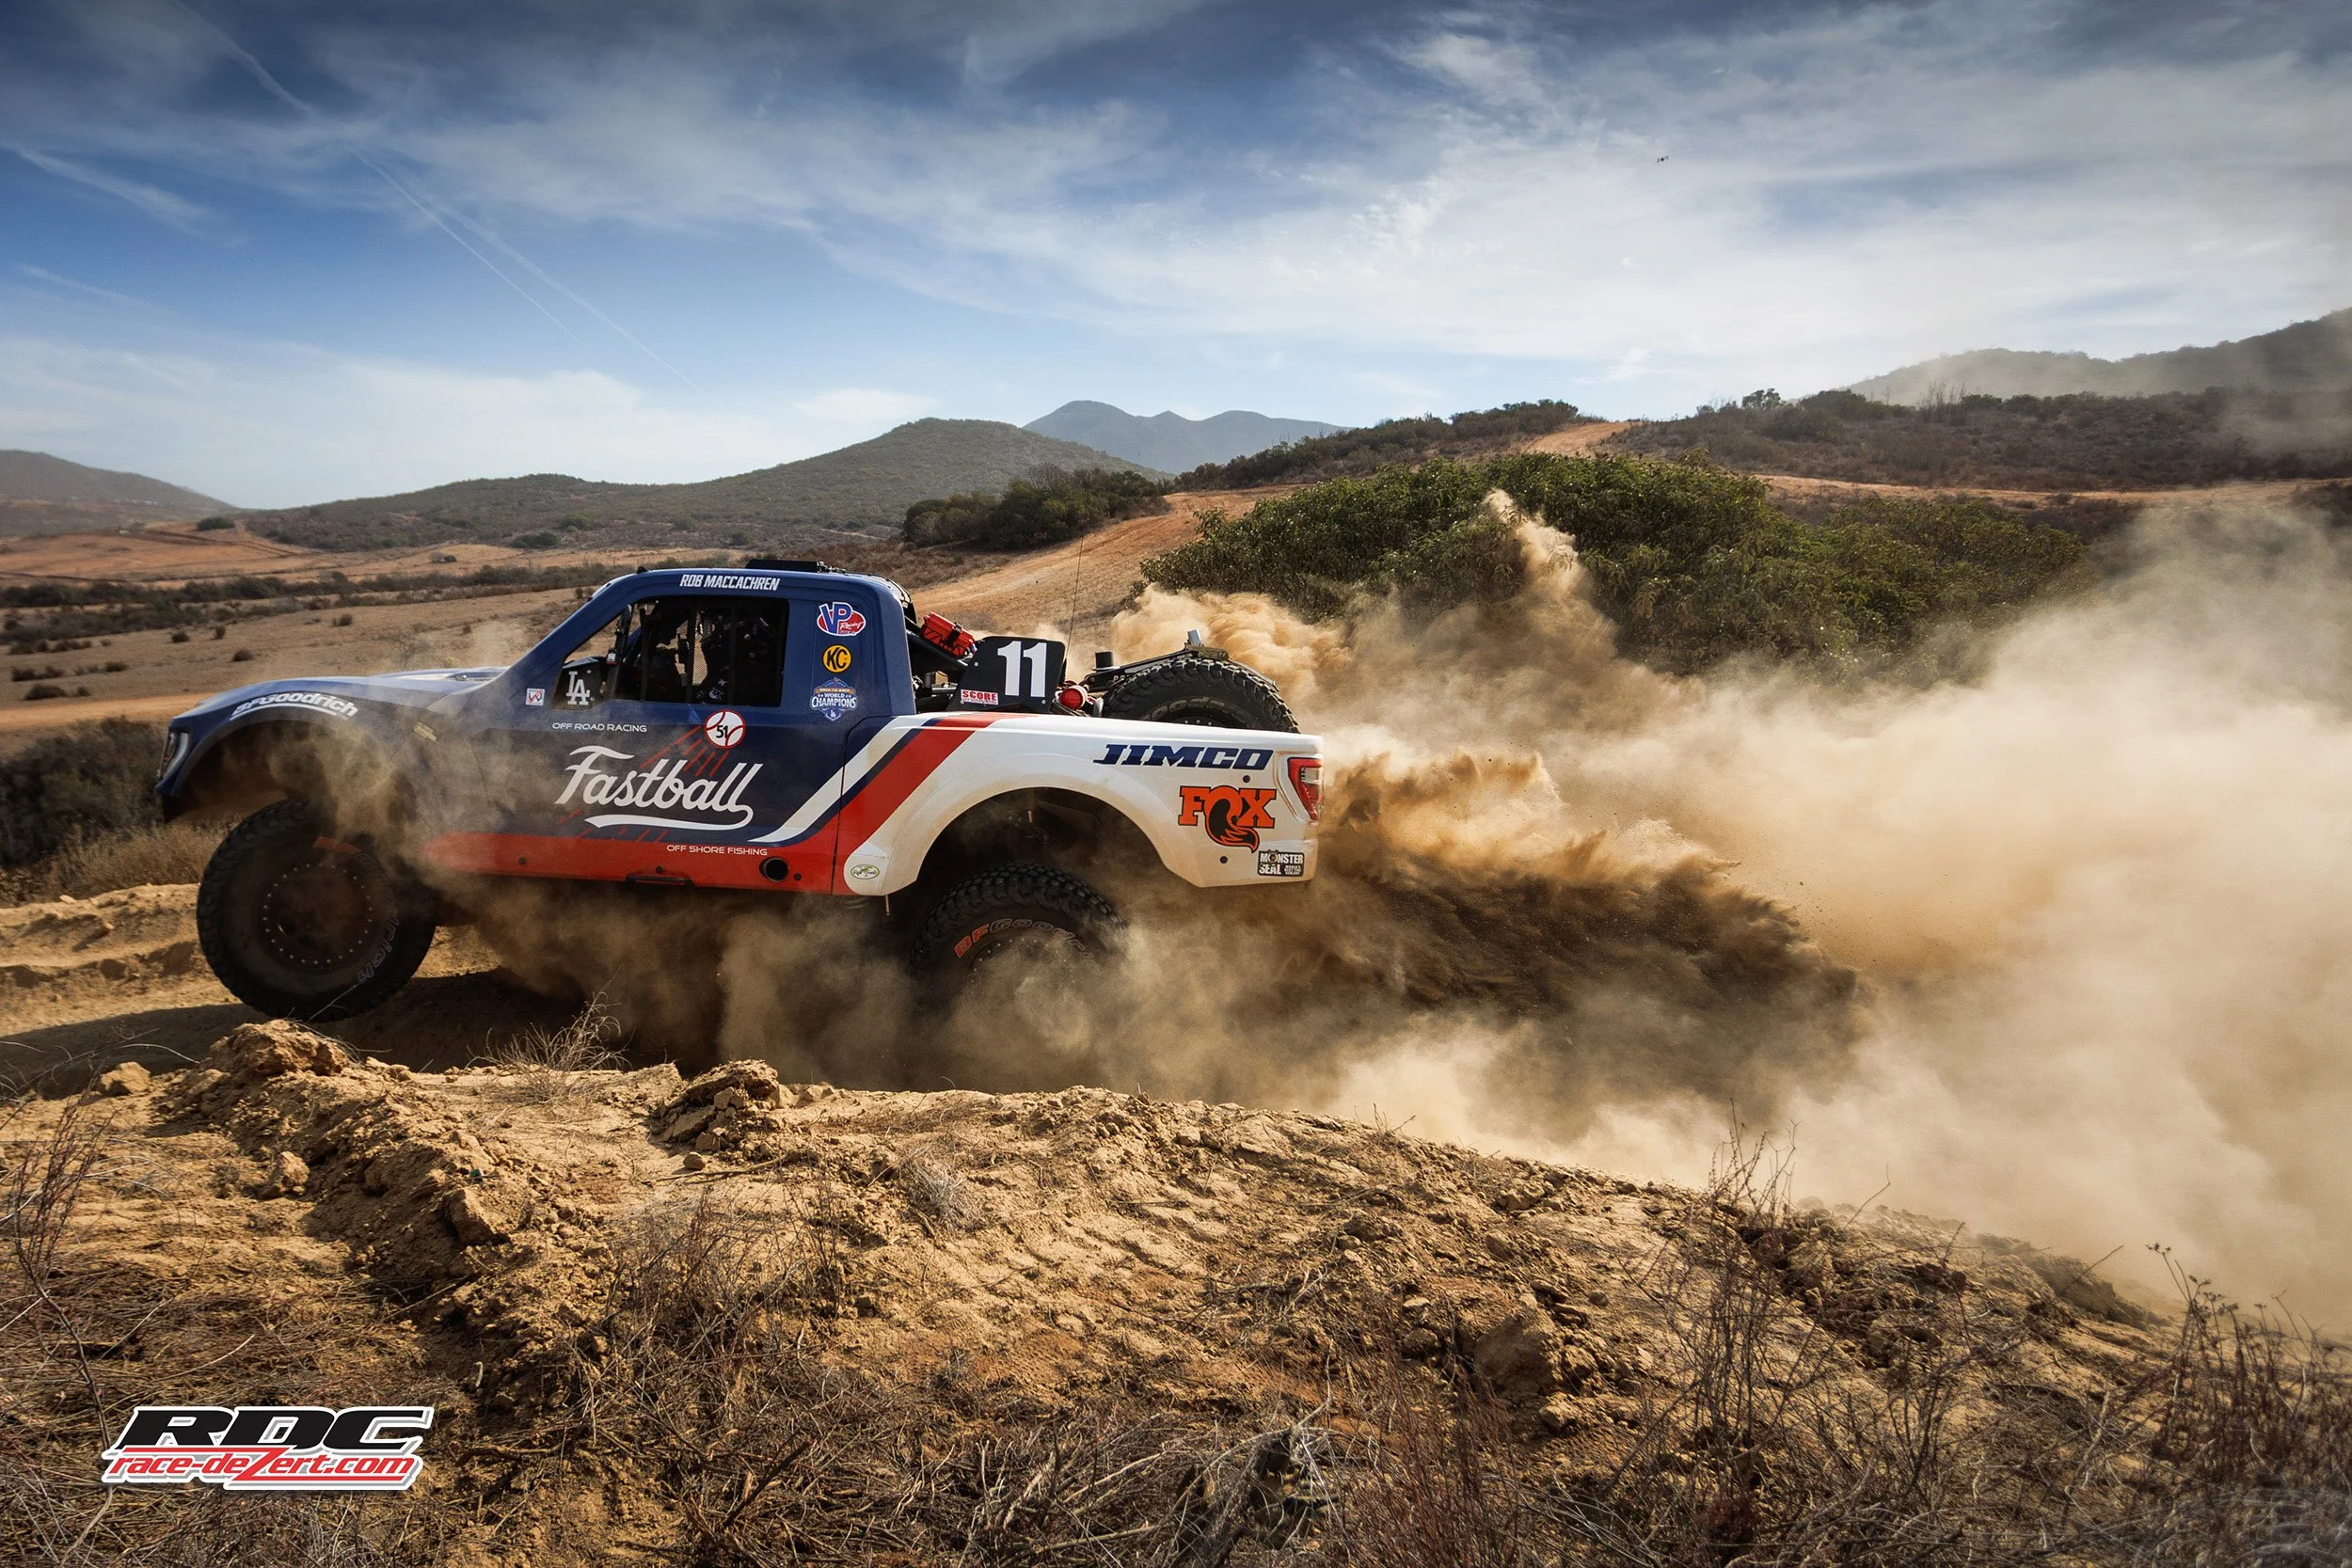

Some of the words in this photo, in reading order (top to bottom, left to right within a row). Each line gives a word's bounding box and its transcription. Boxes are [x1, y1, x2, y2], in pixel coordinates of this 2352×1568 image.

[679, 574, 704, 587] ROB
[704, 575, 781, 591] MACCACHREN
[818, 601, 853, 636] VP
[826, 646, 848, 670] KC
[997, 641, 1047, 698] 11
[565, 671, 591, 705] LA
[962, 690, 997, 701] SCORE
[811, 696, 857, 708] CHAMPIONS
[574, 722, 605, 731] ROAD
[607, 723, 647, 732] RACING
[716, 725, 728, 738] 51
[1093, 743, 1274, 770] JIMCO
[555, 745, 763, 831] Fastball
[1178, 785, 1277, 840] FOX
[689, 845, 725, 854] SHORE
[1260, 851, 1303, 863] MONSTER
[1259, 863, 1281, 875] SEAL
